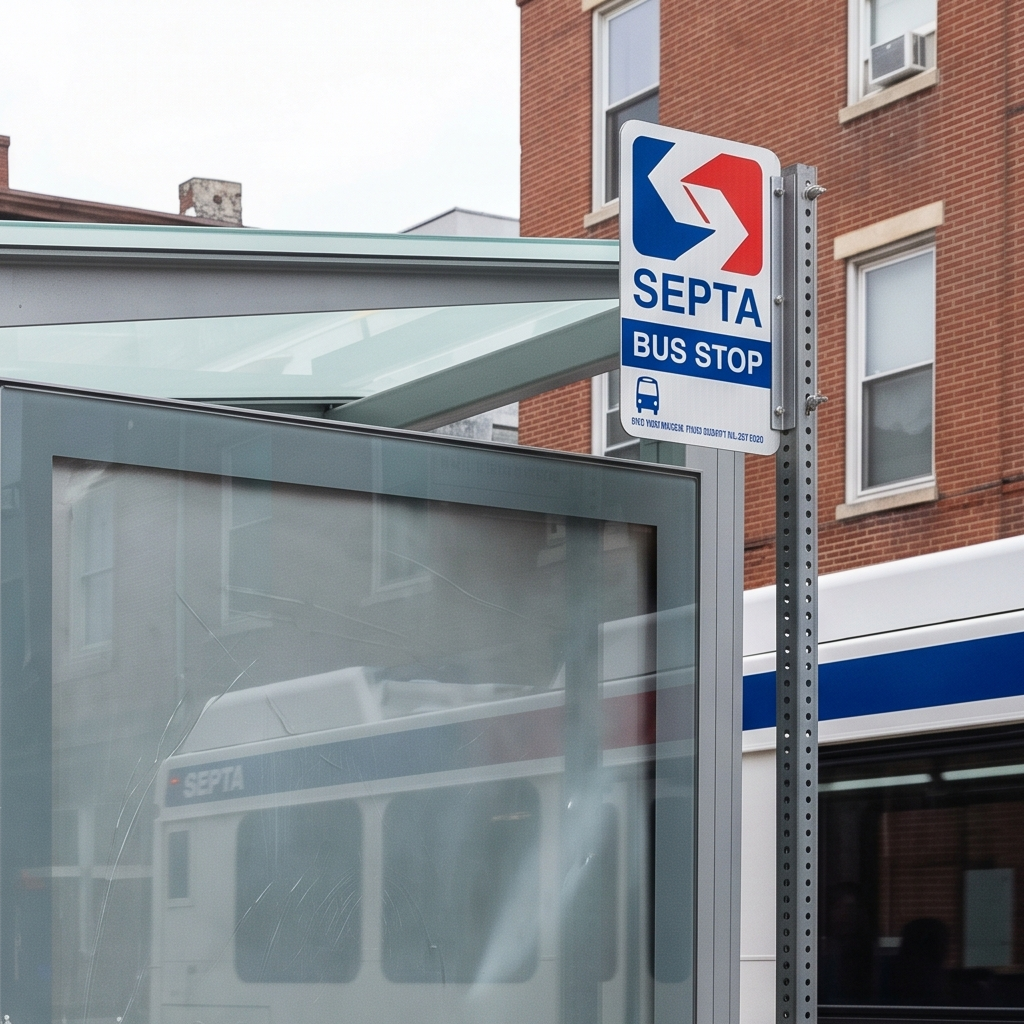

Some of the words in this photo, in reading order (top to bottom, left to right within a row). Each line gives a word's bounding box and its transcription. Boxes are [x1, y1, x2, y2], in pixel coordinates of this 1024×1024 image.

[633, 268, 762, 328] SEPTA
[633, 331, 687, 364] BUS
[695, 341, 763, 375] STOP
[183, 765, 244, 798] SEPTA
